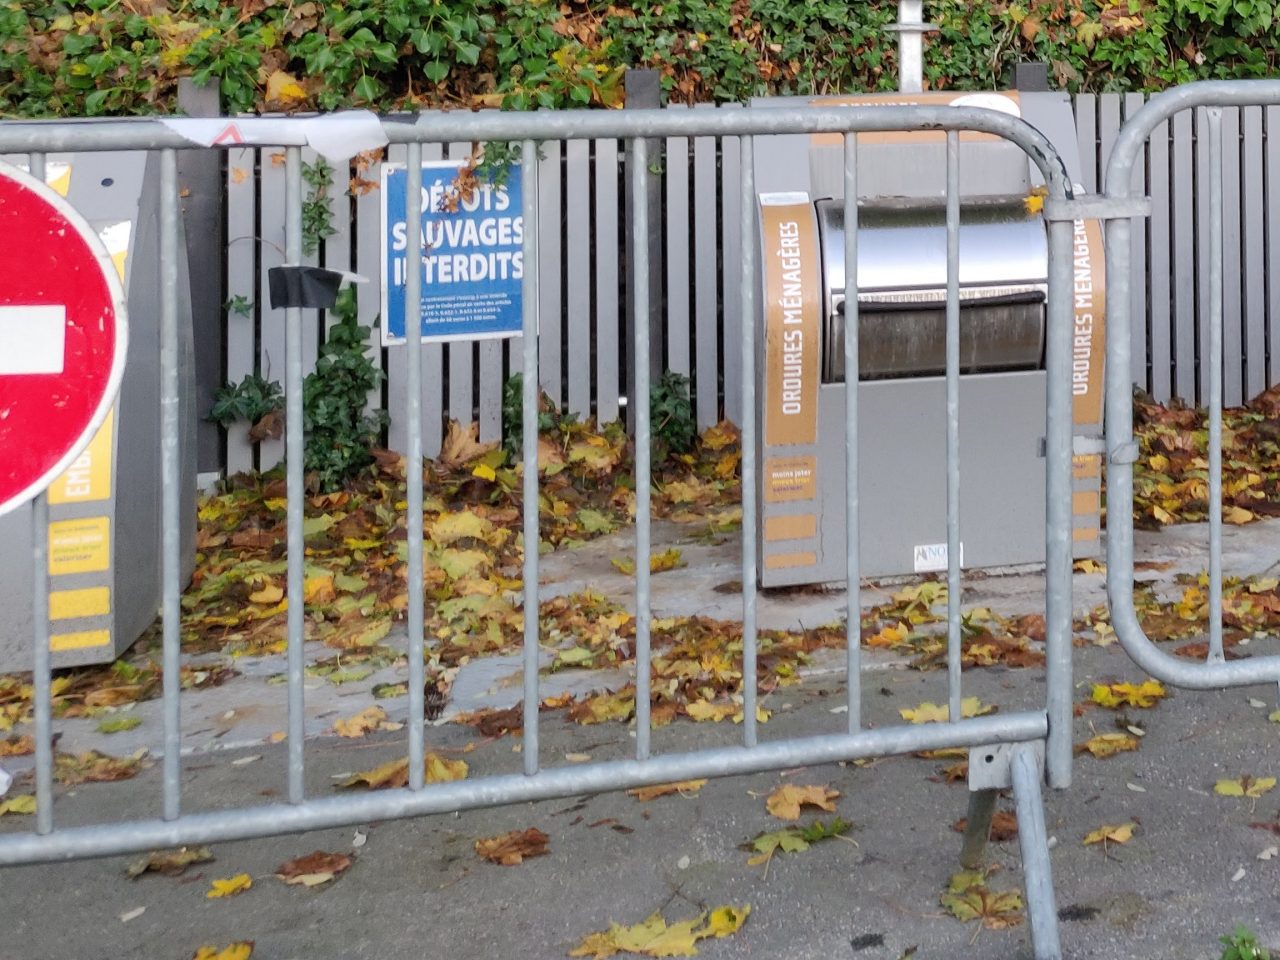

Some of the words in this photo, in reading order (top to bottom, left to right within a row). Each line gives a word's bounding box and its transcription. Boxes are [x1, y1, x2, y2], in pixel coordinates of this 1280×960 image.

[392, 216, 523, 250] SUVAGES
[394, 251, 523, 286] ITERDITS
[776, 221, 802, 325] MÉNAGÈRES
[782, 330, 803, 415] ORDURES
